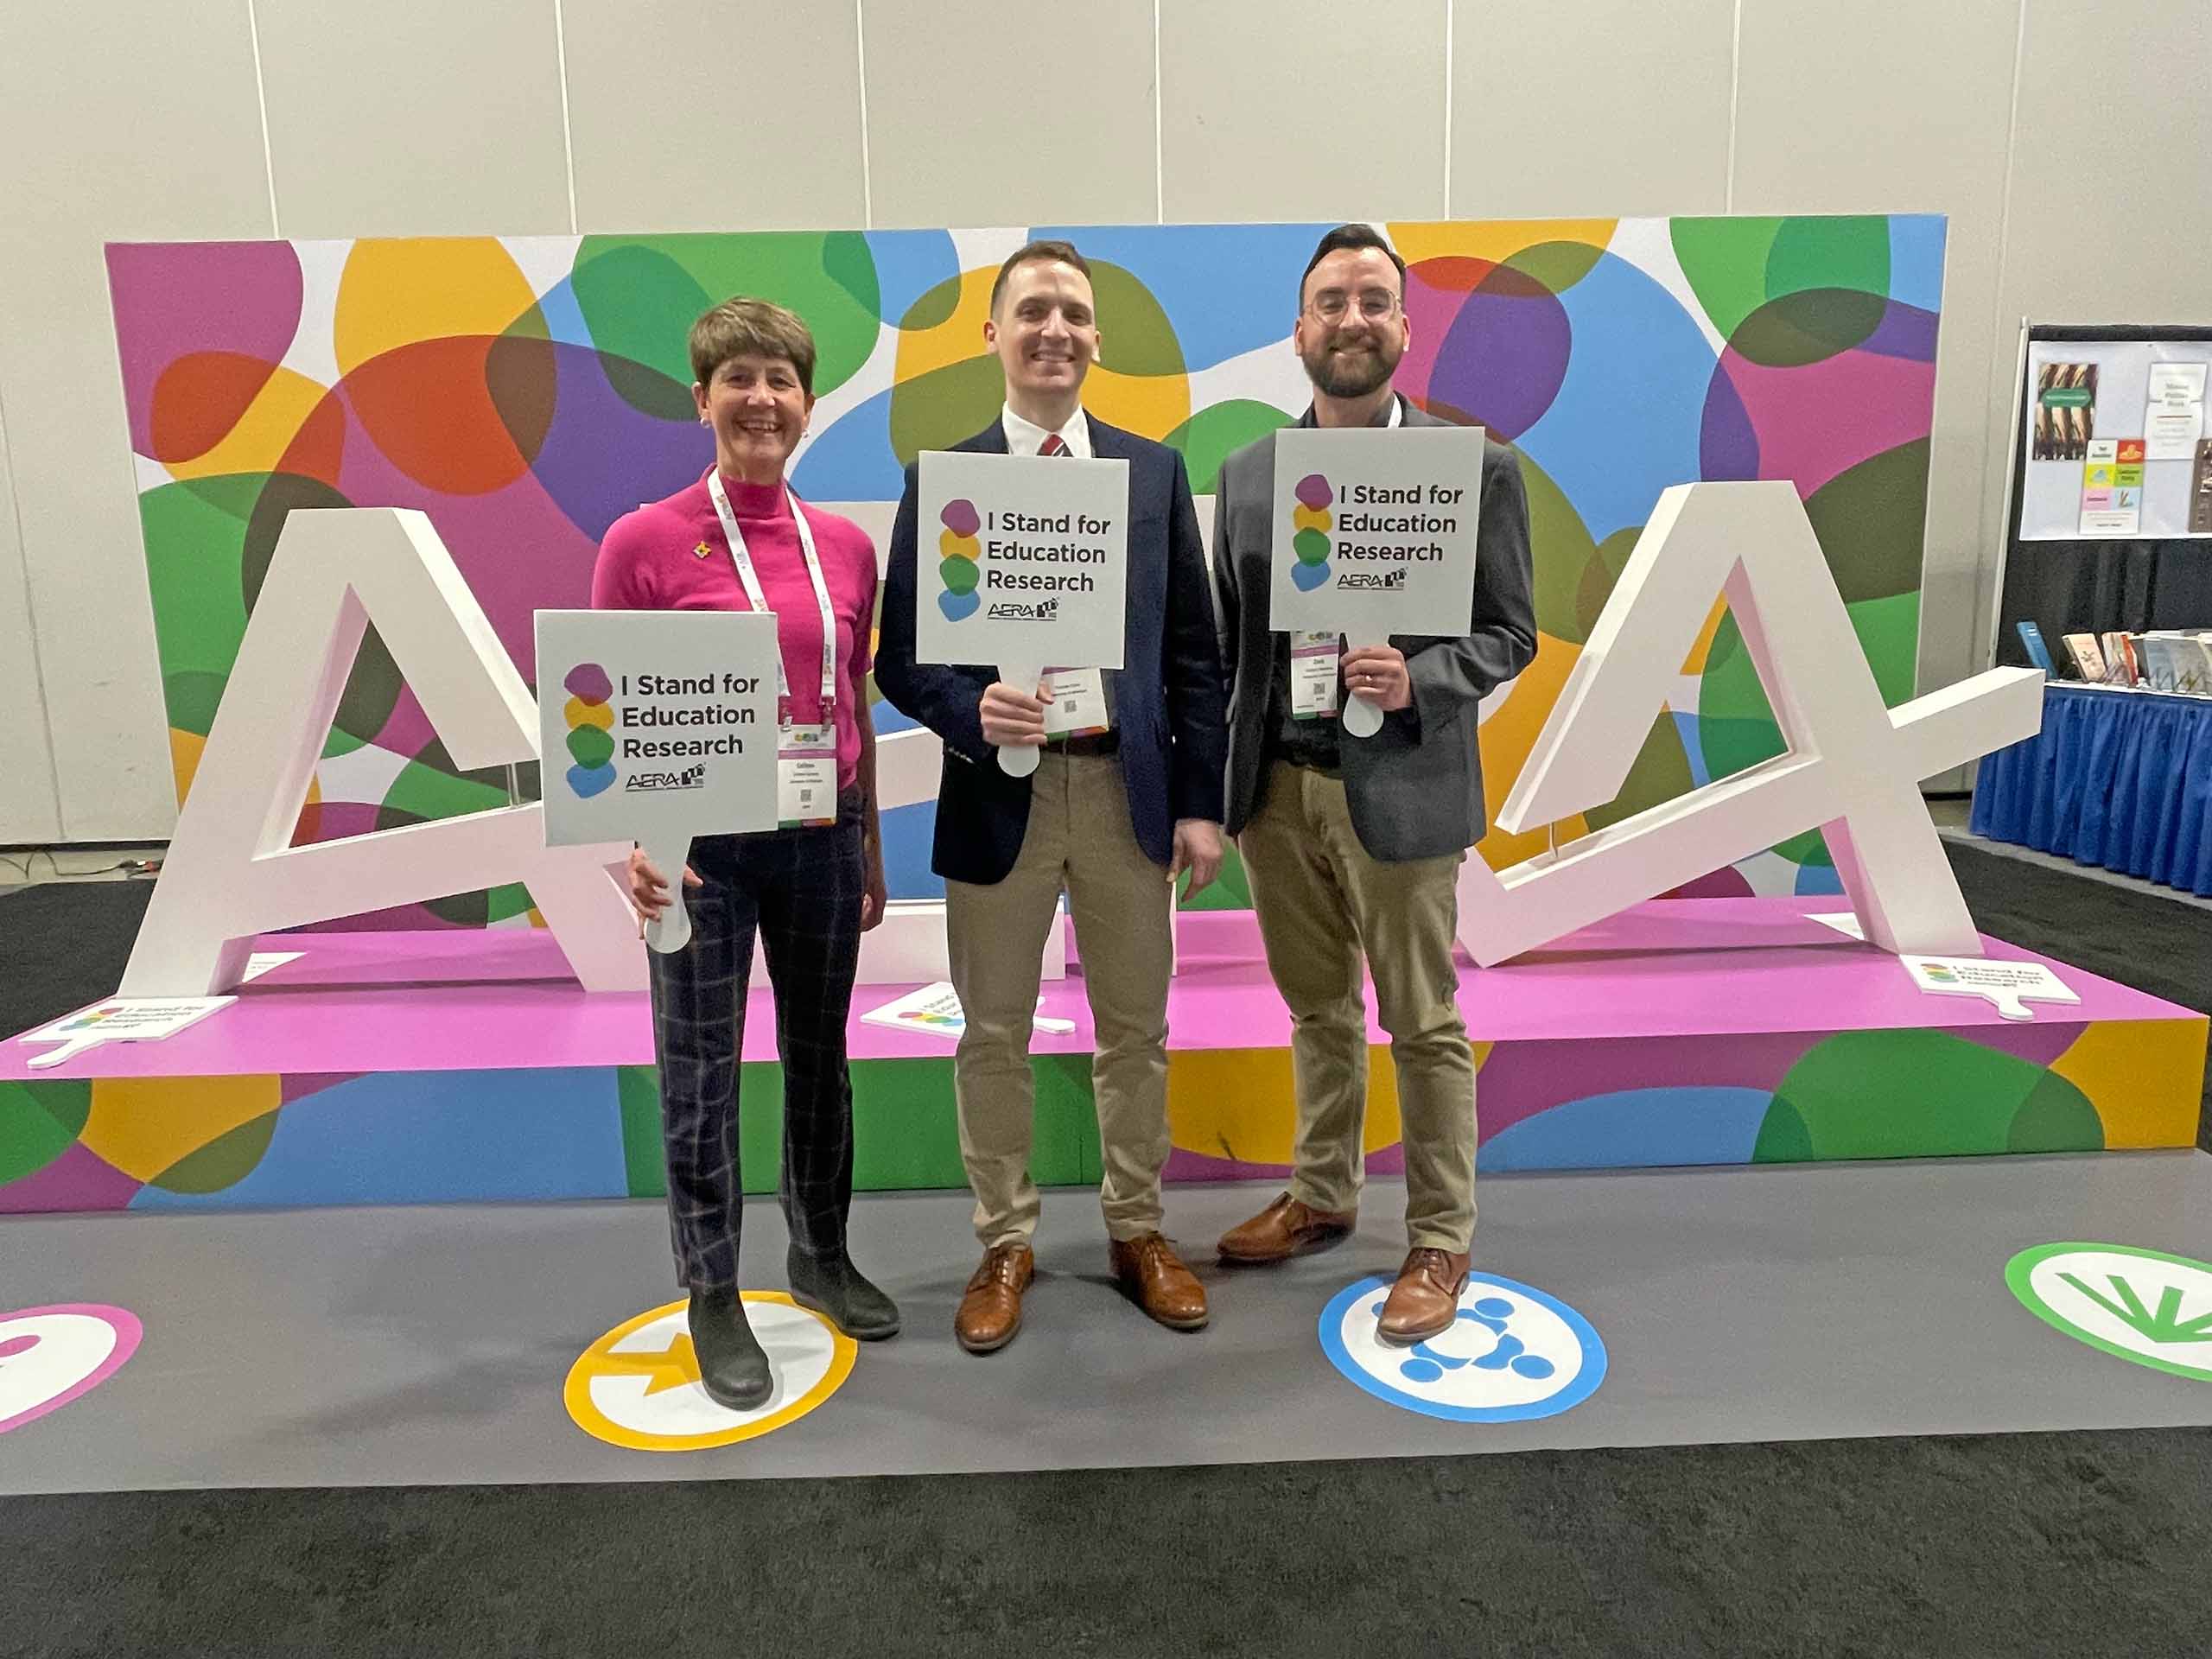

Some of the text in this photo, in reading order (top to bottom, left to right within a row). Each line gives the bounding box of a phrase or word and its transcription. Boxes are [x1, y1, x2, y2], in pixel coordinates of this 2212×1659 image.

[1340, 485, 1464, 505] I Stand for
[988, 512, 1111, 535] I Stand for
[1339, 513, 1457, 533] Education
[988, 541, 1106, 563] Education
[1338, 542, 1443, 562] Research
[988, 569, 1094, 592] Research
[1337, 574, 1384, 588] AERA
[988, 603, 1036, 618] AERA
[621, 673, 760, 696] I Stand for
[622, 704, 755, 728] Education
[624, 734, 743, 759] Research
[626, 772, 680, 788] AERA
